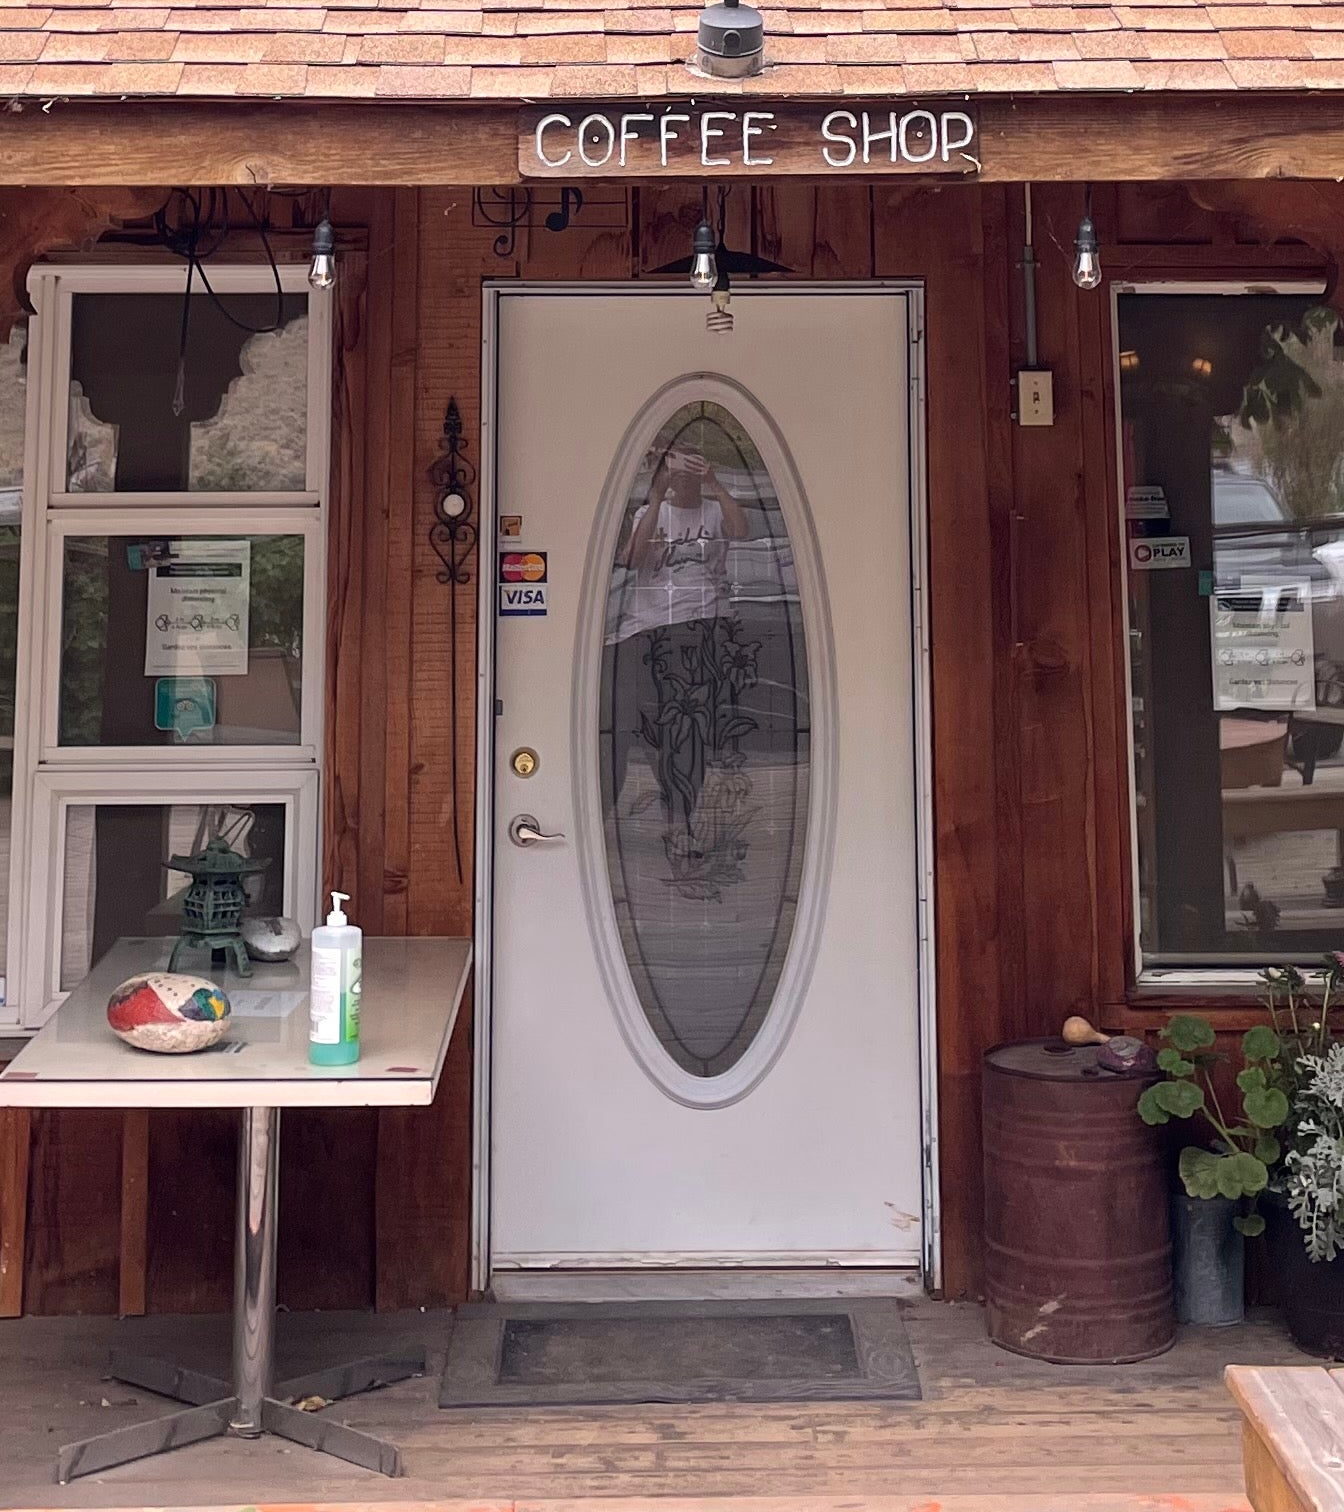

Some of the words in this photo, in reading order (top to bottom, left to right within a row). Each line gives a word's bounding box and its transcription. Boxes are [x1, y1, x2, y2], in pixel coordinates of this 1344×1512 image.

[535, 112, 775, 167] COFFEE
[821, 110, 974, 167] SHOP
[1153, 547, 1186, 558] PLAY
[506, 590, 545, 604] VISA
